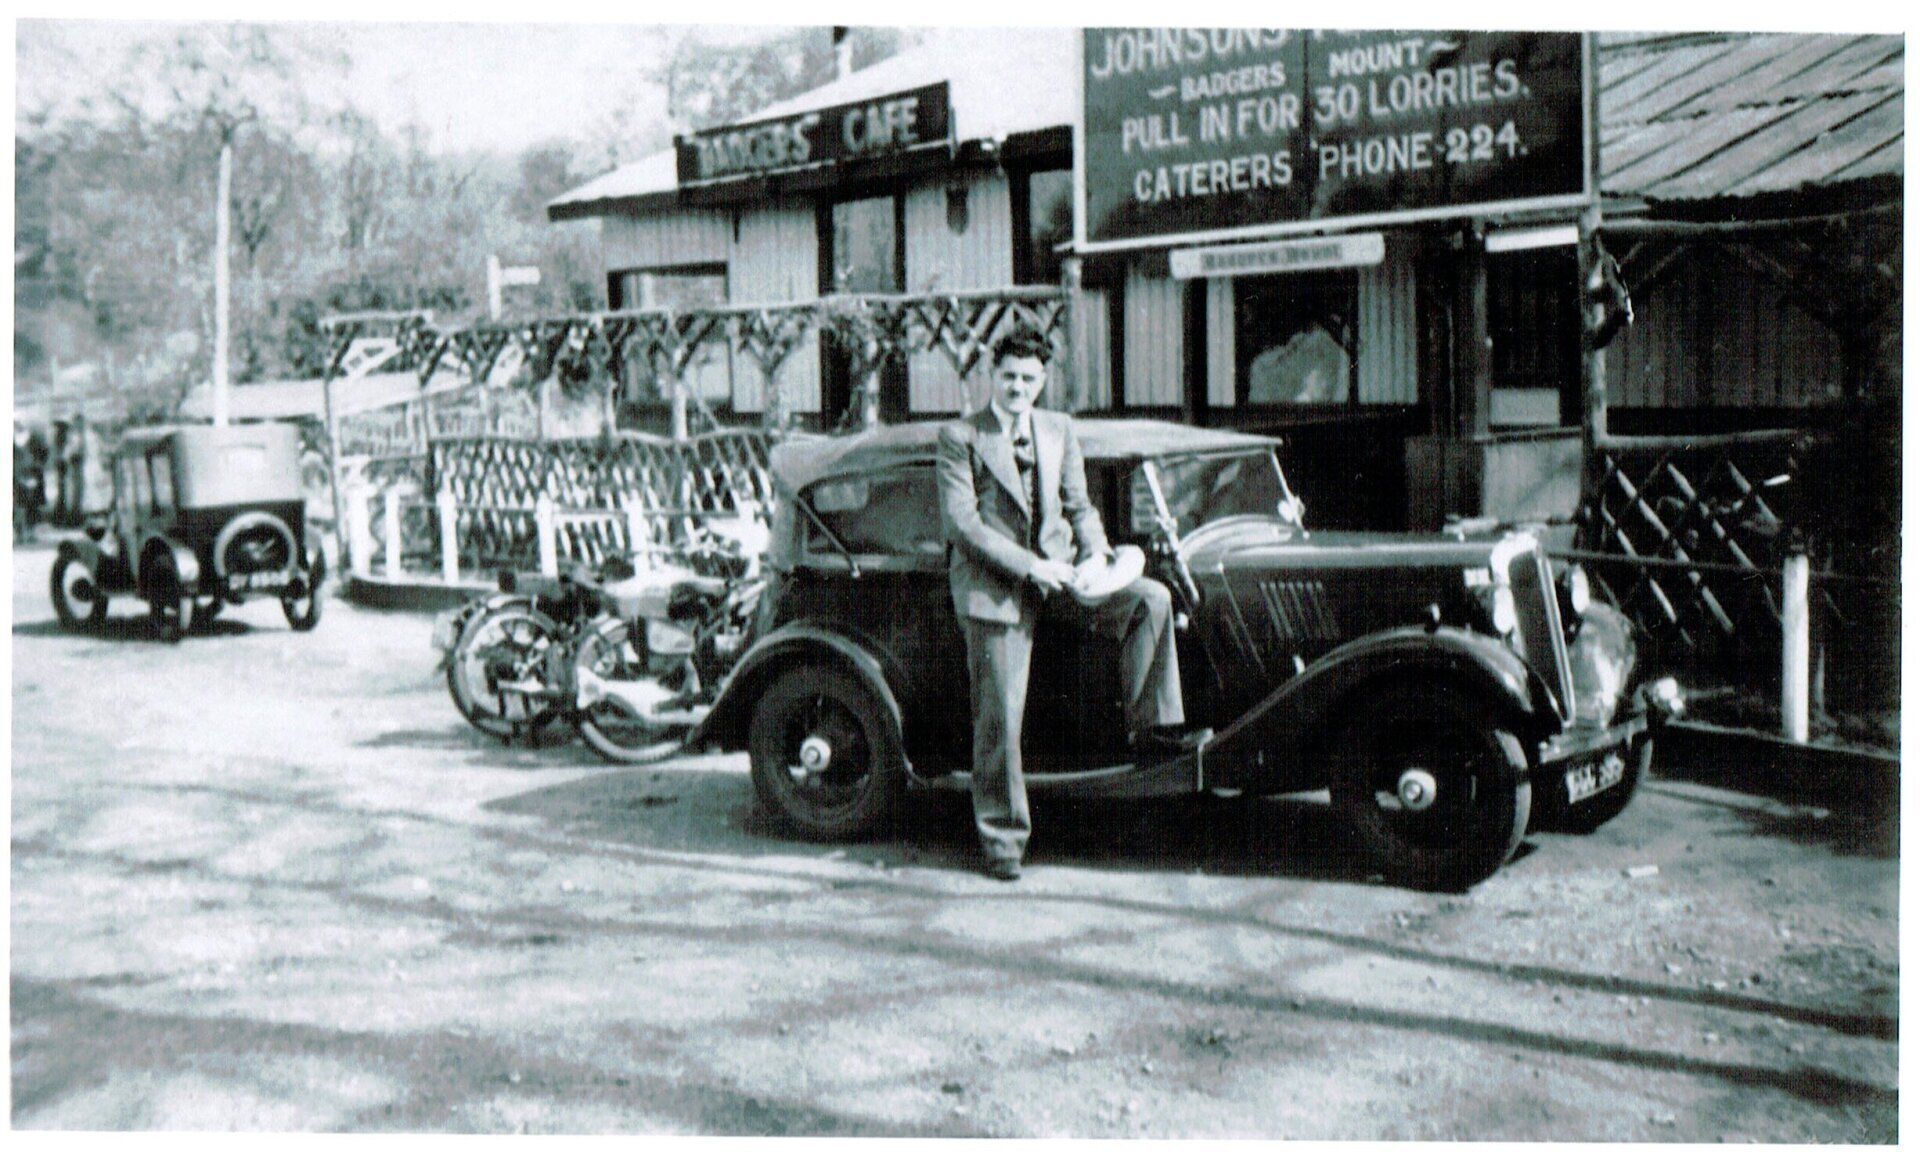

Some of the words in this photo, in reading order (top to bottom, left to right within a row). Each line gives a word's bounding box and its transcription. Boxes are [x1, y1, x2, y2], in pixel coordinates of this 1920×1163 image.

[1181, 61, 1287, 102] BADGERS
[1329, 39, 1425, 77] MOUNT
[1122, 112, 1189, 153] PULL
[1200, 103, 1230, 143] IN
[1237, 93, 1299, 138] FOR
[1313, 83, 1360, 125] 30
[1134, 151, 1293, 202] CATERERS
